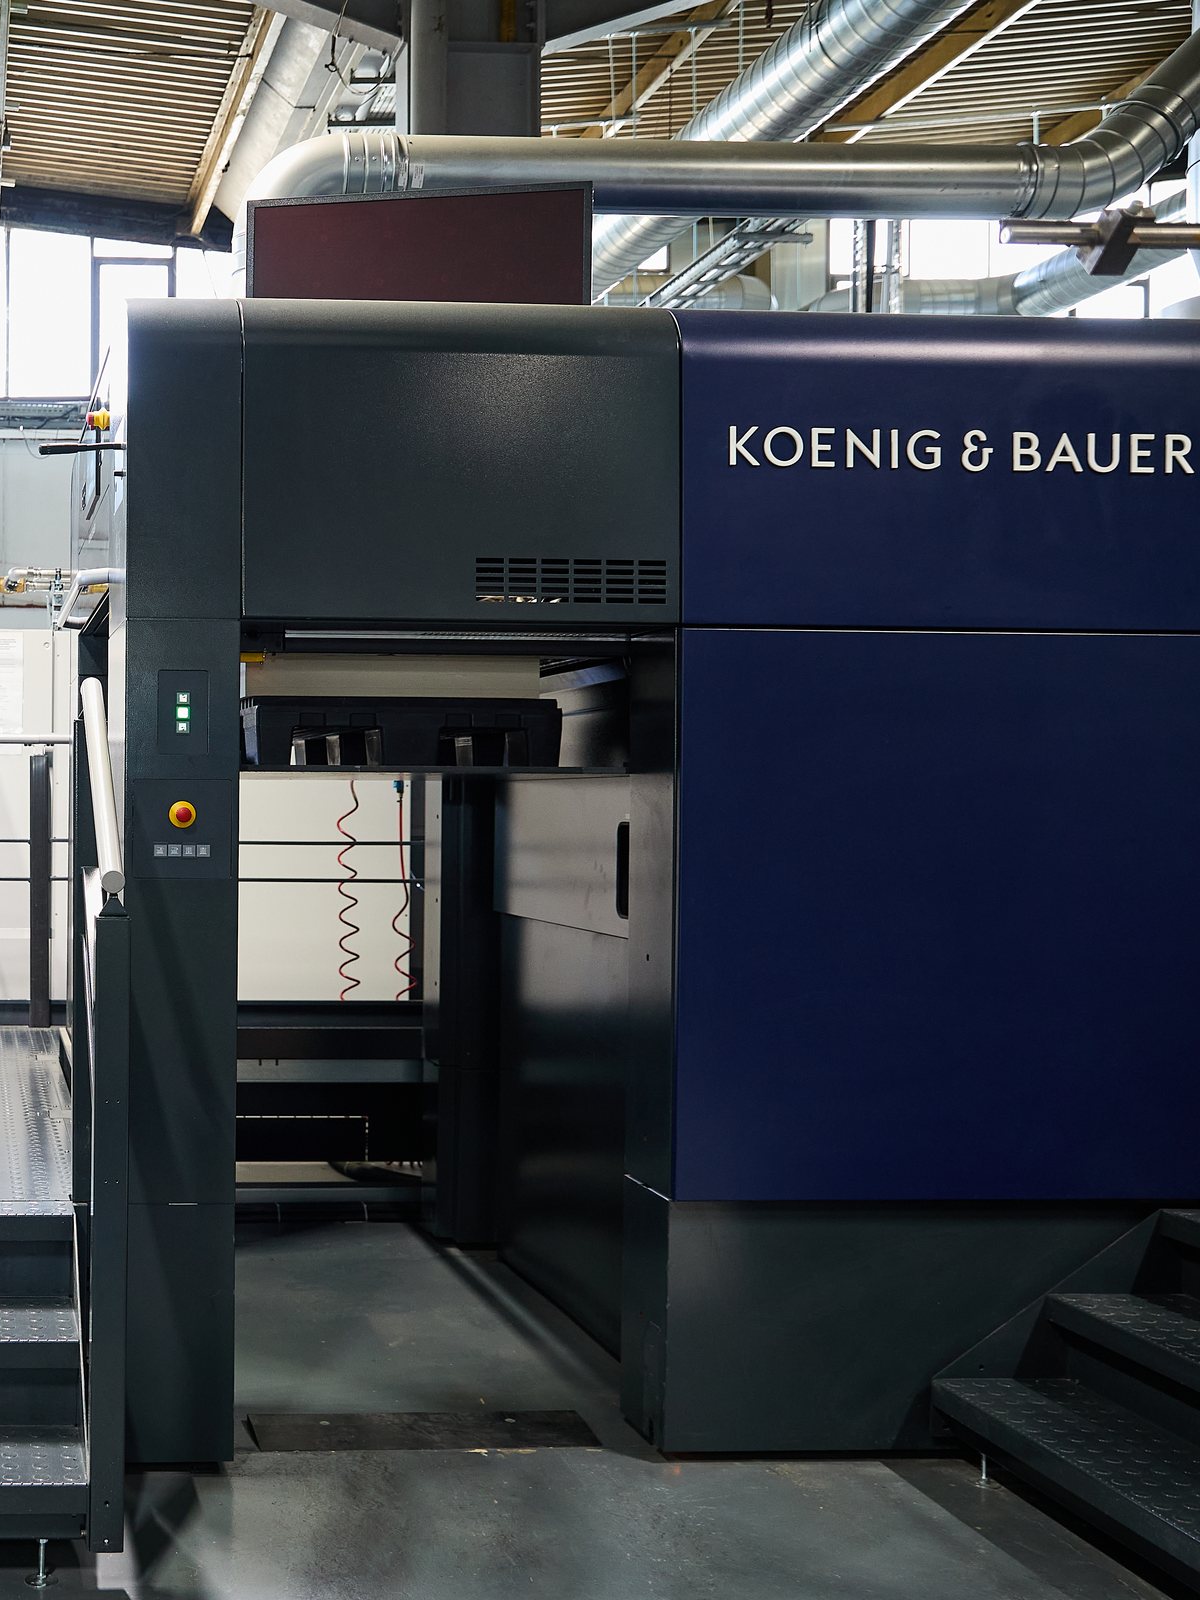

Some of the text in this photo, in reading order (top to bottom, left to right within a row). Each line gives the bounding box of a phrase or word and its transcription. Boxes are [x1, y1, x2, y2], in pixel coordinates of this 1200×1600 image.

[728, 425, 1195, 474] KOENIG & BAUER
